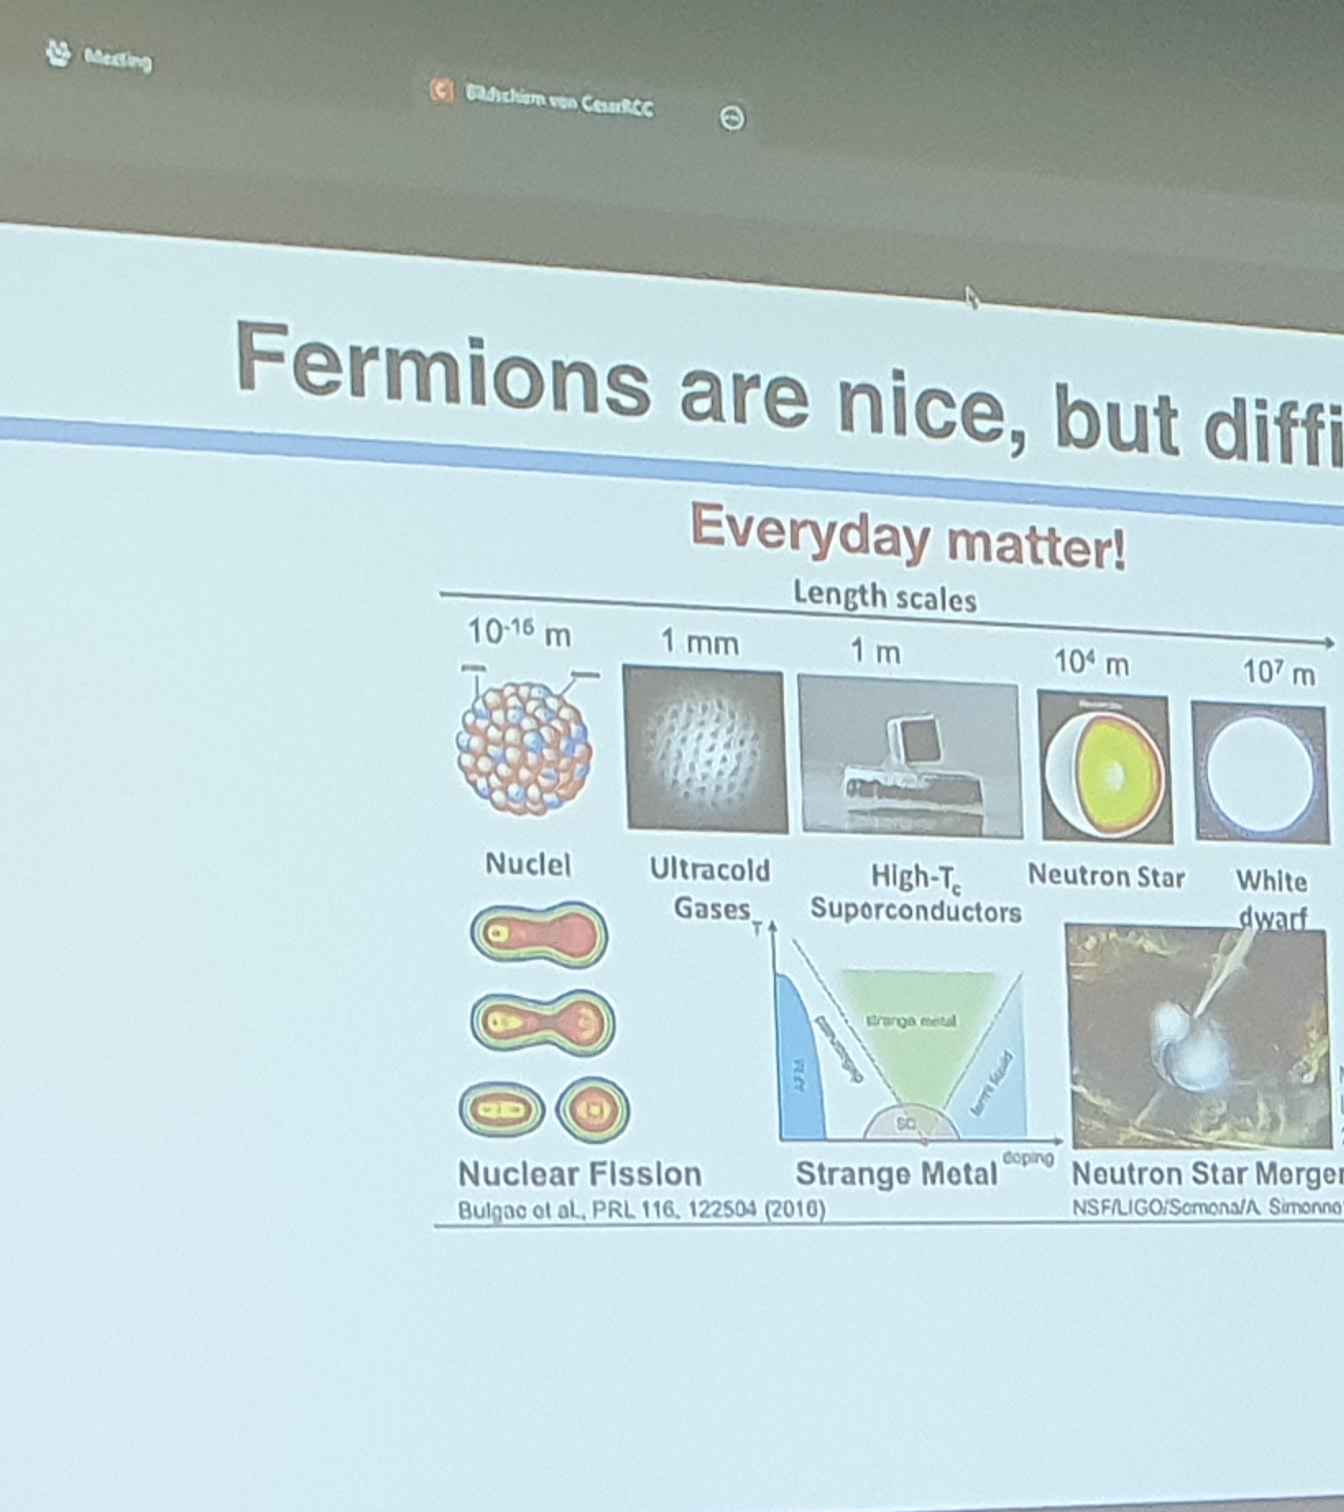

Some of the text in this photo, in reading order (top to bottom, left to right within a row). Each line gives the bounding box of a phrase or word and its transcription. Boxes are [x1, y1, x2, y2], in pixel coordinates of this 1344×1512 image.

[237, 319, 651, 418] Fermions
[681, 367, 809, 429] are
[839, 368, 1025, 459] nice,
[1055, 382, 1180, 458] but
[691, 500, 1126, 571] Everyday matter!
[793, 578, 978, 613] Length scales
[544, 624, 572, 648] m
[661, 626, 740, 657] 1 mm
[850, 635, 902, 666] 1 m
[1105, 655, 1131, 678] m
[1292, 666, 1317, 688] m
[486, 851, 572, 878] Nuclei
[650, 855, 771, 883] Ultracold
[1028, 862, 1187, 890] Neutron Star
[1236, 868, 1309, 894] White
[674, 894, 751, 921] Gases
[810, 896, 1023, 925] Superconductors
[1239, 904, 1309, 932] dwarf
[920, 1014, 957, 1028] metal
[458, 1159, 703, 1188] Nuclear Fission
[1002, 1150, 1055, 1169] doping
[1072, 1159, 1183, 1187] Neutron
[1191, 1159, 1249, 1187] Star
[796, 1159, 998, 1192] Strange Metal
[532, 1200, 552, 1220] et
[591, 1199, 636, 1220] PRL
